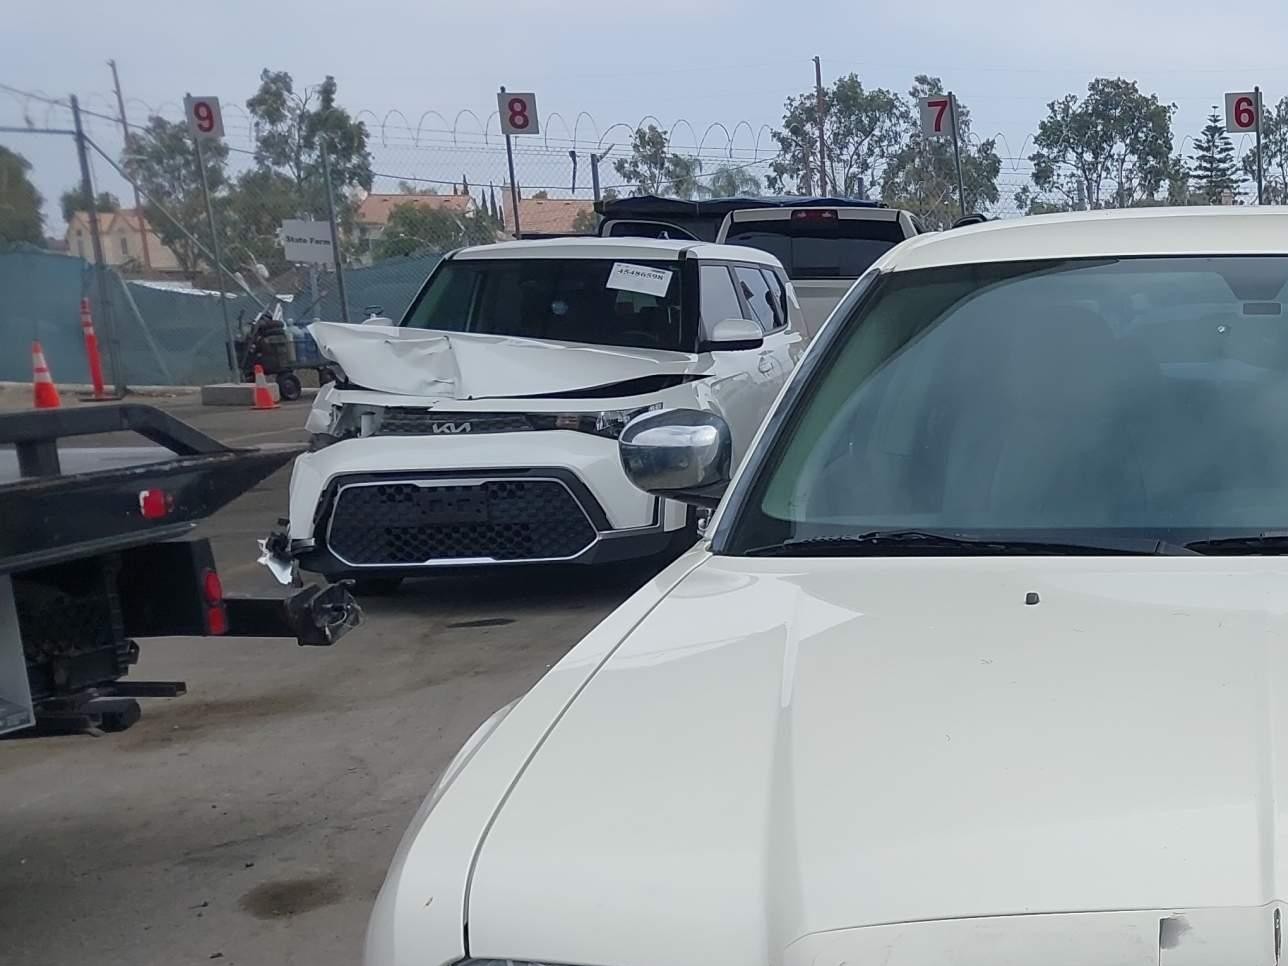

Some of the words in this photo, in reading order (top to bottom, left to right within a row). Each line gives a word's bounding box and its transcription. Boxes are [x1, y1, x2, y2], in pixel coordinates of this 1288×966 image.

[194, 102, 214, 132] 9
[508, 98, 529, 129] 8
[928, 101, 947, 132] 7
[1235, 97, 1254, 128] 6
[309, 236, 331, 246] Farm
